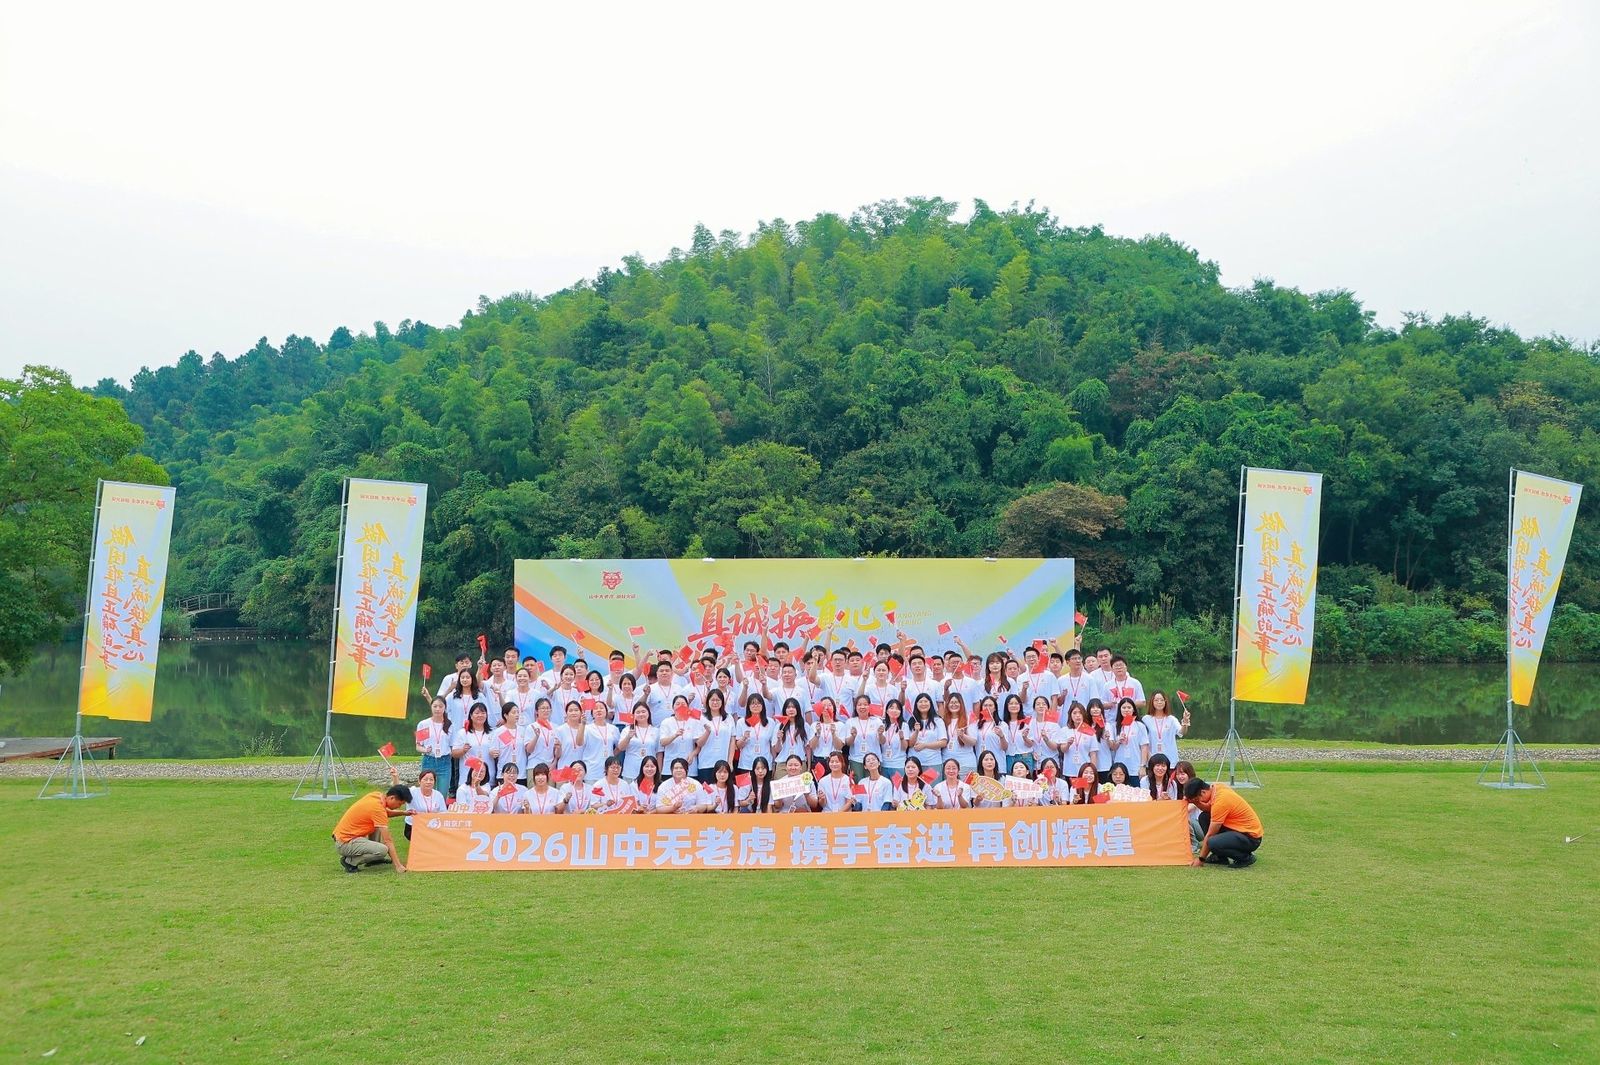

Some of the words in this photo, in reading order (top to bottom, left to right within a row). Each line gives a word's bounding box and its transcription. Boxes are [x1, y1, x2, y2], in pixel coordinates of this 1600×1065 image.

[687, 582, 897, 643] 真诚换真心
[465, 827, 777, 867] 2026山中无老虎
[789, 822, 957, 866] 携手奋进
[967, 816, 1136, 862] 再创辉煌
